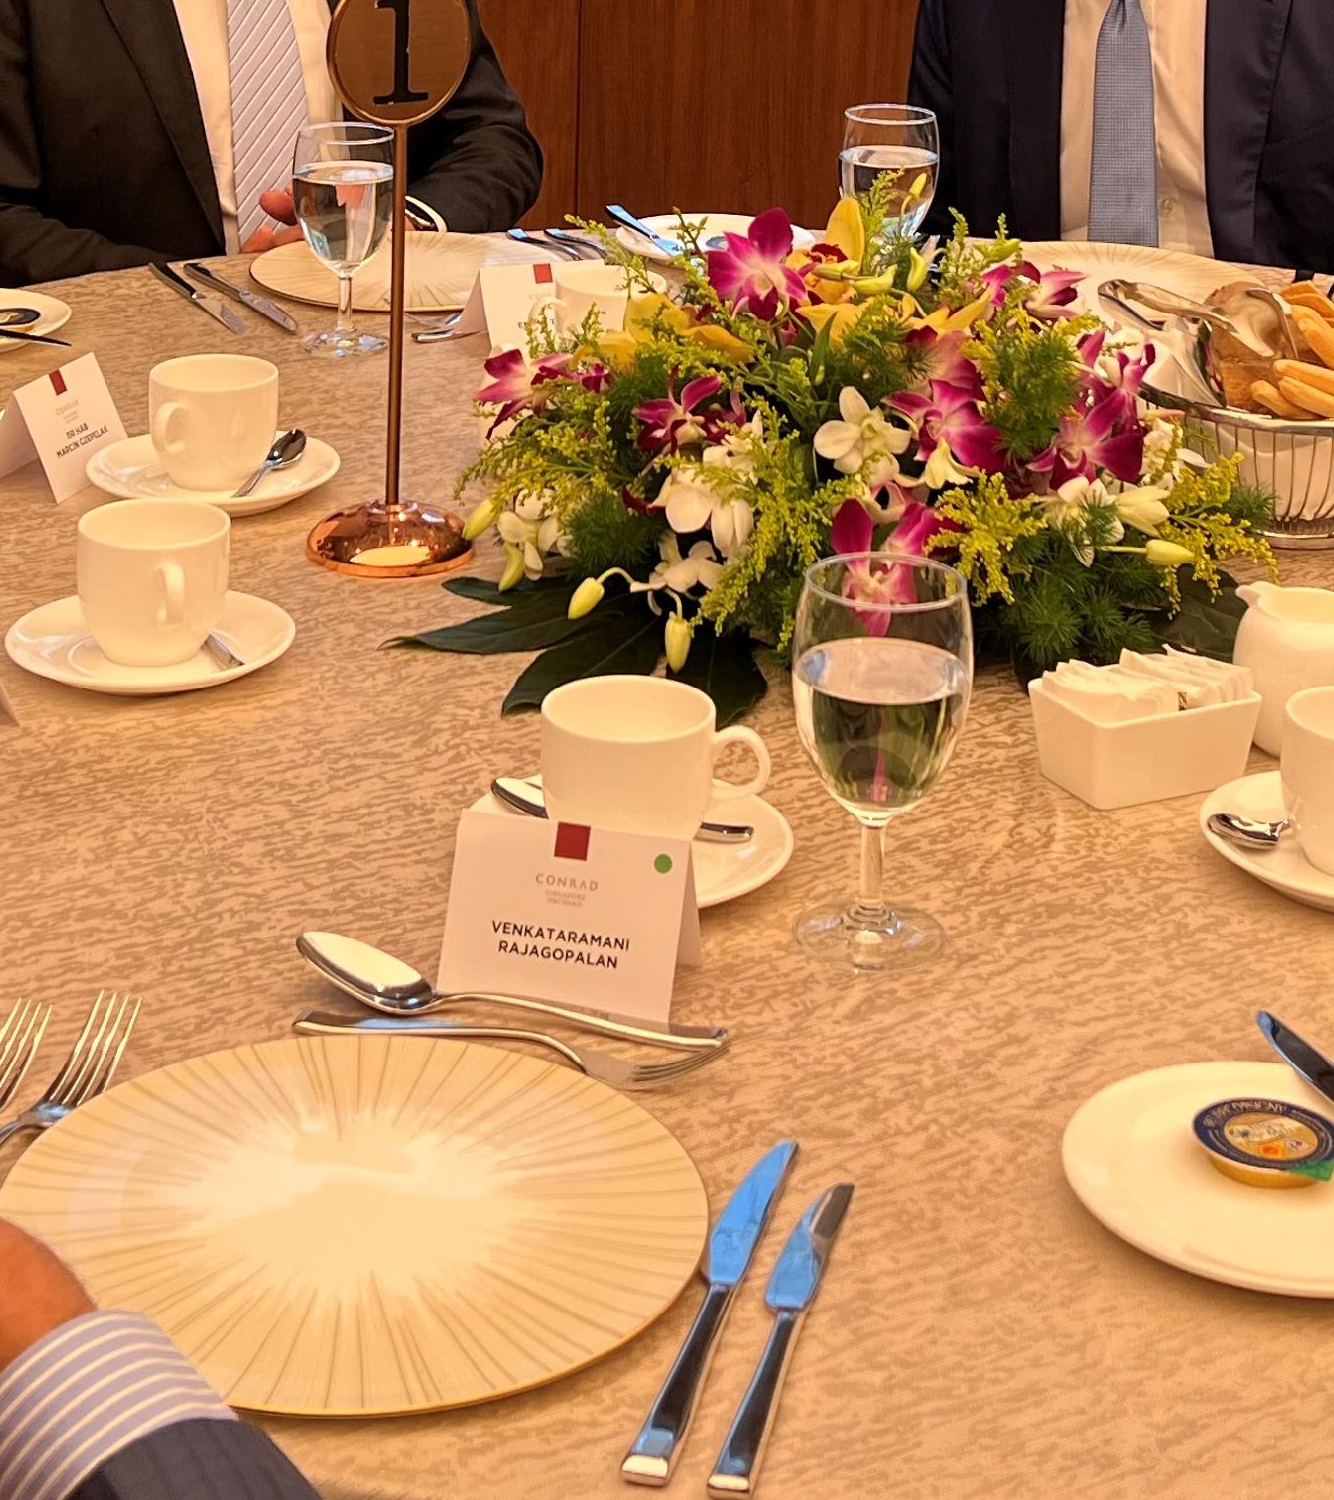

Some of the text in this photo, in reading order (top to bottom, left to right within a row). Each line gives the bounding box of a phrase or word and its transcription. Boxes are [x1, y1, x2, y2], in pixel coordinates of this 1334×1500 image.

[535, 873, 599, 892] CONRAD
[492, 920, 631, 952] VENKATARAMANI
[498, 939, 618, 969] RAJAGOPALAN
